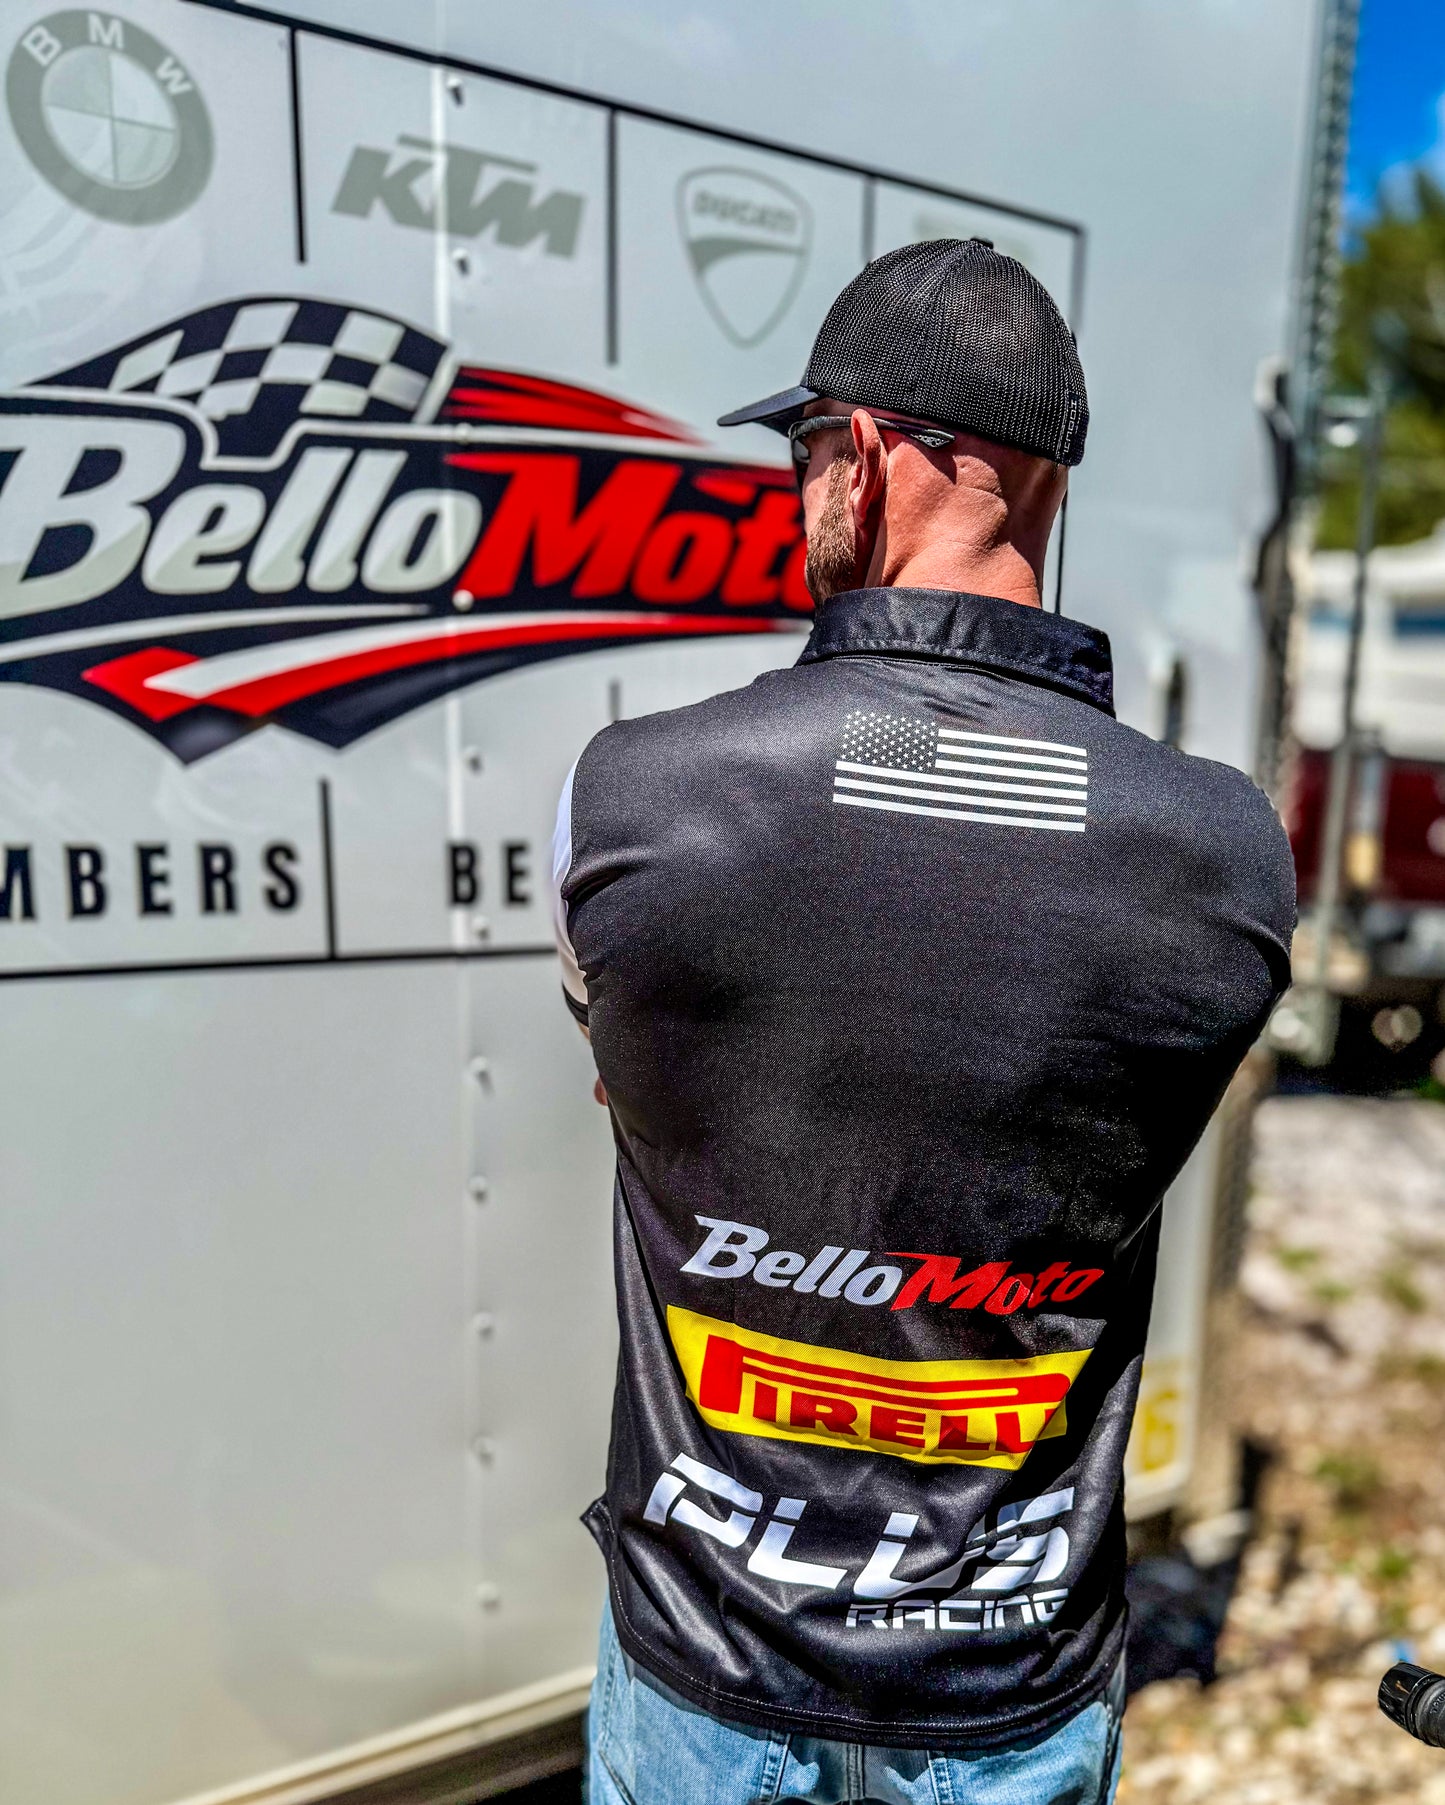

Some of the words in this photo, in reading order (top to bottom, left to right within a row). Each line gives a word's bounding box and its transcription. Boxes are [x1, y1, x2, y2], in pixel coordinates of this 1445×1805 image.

[22, 13, 193, 98] BMW
[331, 134, 586, 260] KTM
[693, 189, 799, 236] DUCATI
[699, 1333, 1071, 1455] PIRELL
[642, 1452, 1076, 1600] PLUS
